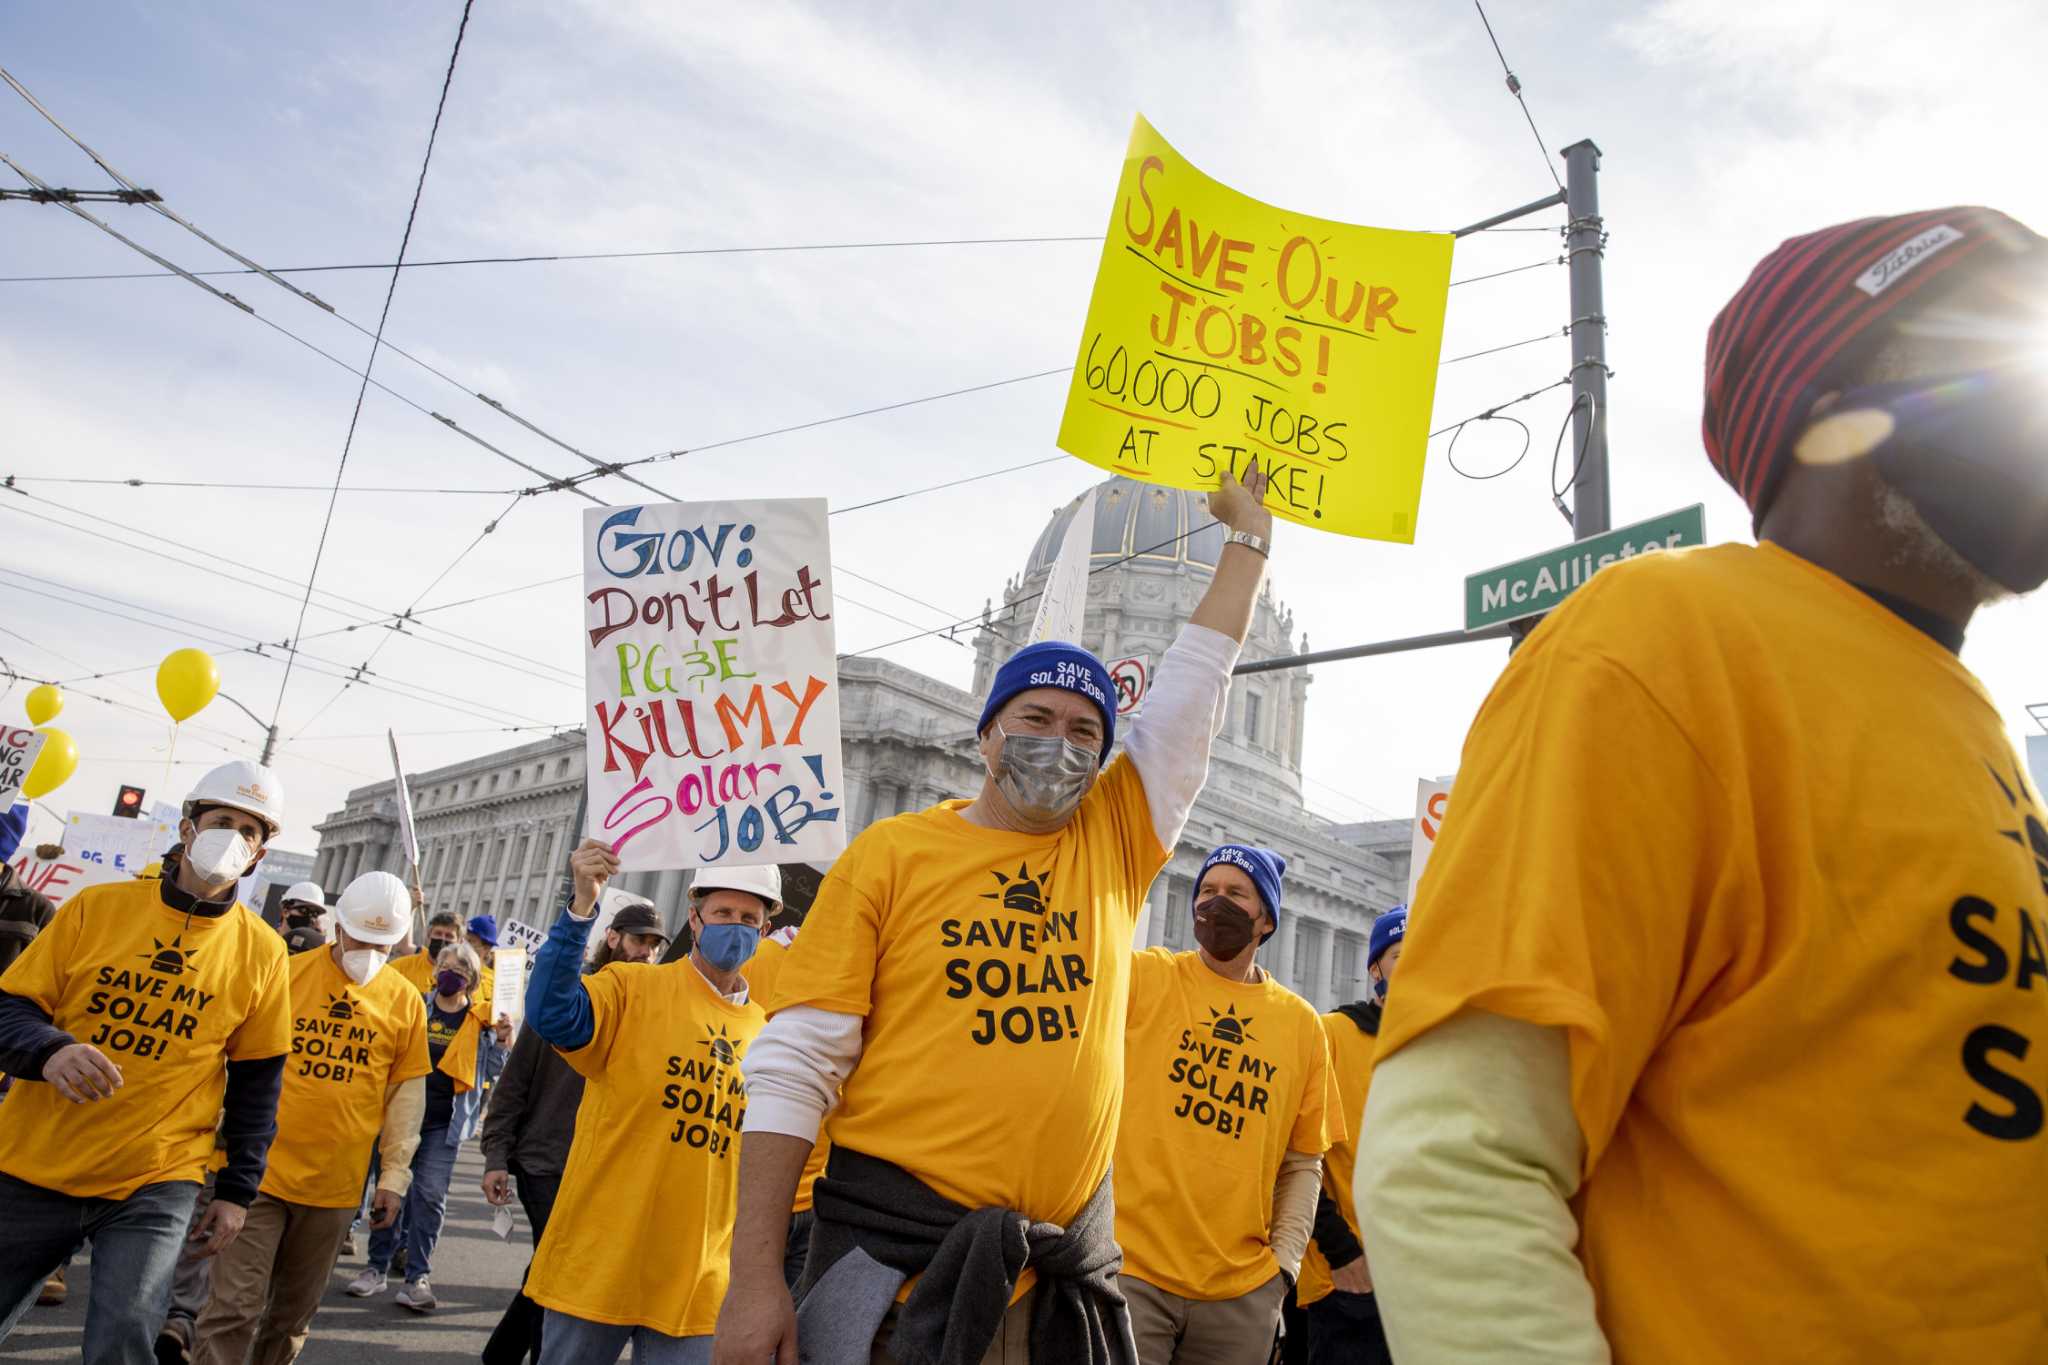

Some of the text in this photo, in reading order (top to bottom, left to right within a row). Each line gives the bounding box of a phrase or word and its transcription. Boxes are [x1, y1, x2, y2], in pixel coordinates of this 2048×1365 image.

[1125, 156, 1416, 334] SAVE OUR
[1150, 281, 1330, 394] JOBS!
[1086, 333, 1347, 461] 60,000 JOBS
[1118, 426, 1325, 519] AT STAKE!
[1482, 532, 1682, 612] McAllir
[587, 565, 830, 649] Don't Let
[1030, 671, 1106, 705] SOLAR JOBS
[1056, 660, 1092, 682] SAVE
[594, 675, 828, 782] Kill MY
[604, 764, 782, 858] Solar
[694, 754, 840, 862] JOB!
[1221, 848, 1244, 857] SAVE
[508, 921, 543, 945] SAVE
[941, 910, 1078, 954] SAVE MY
[96, 966, 215, 1011] SAVE MY
[945, 954, 1094, 1000] SOLAR
[86, 992, 198, 1040] SOLAR
[295, 1018, 377, 1044] SAVE MY
[971, 1005, 1079, 1045] JOB!
[91, 1024, 168, 1061] JOB!
[292, 1037, 369, 1066] SOLAR
[1179, 1029, 1277, 1083] SAVE MY
[299, 1060, 355, 1083] JOB!
[666, 1056, 725, 1090] SAVE
[1168, 1057, 1269, 1115] SOLAR
[671, 1119, 731, 1159] JOB!
[1174, 1093, 1245, 1140] JOB!
